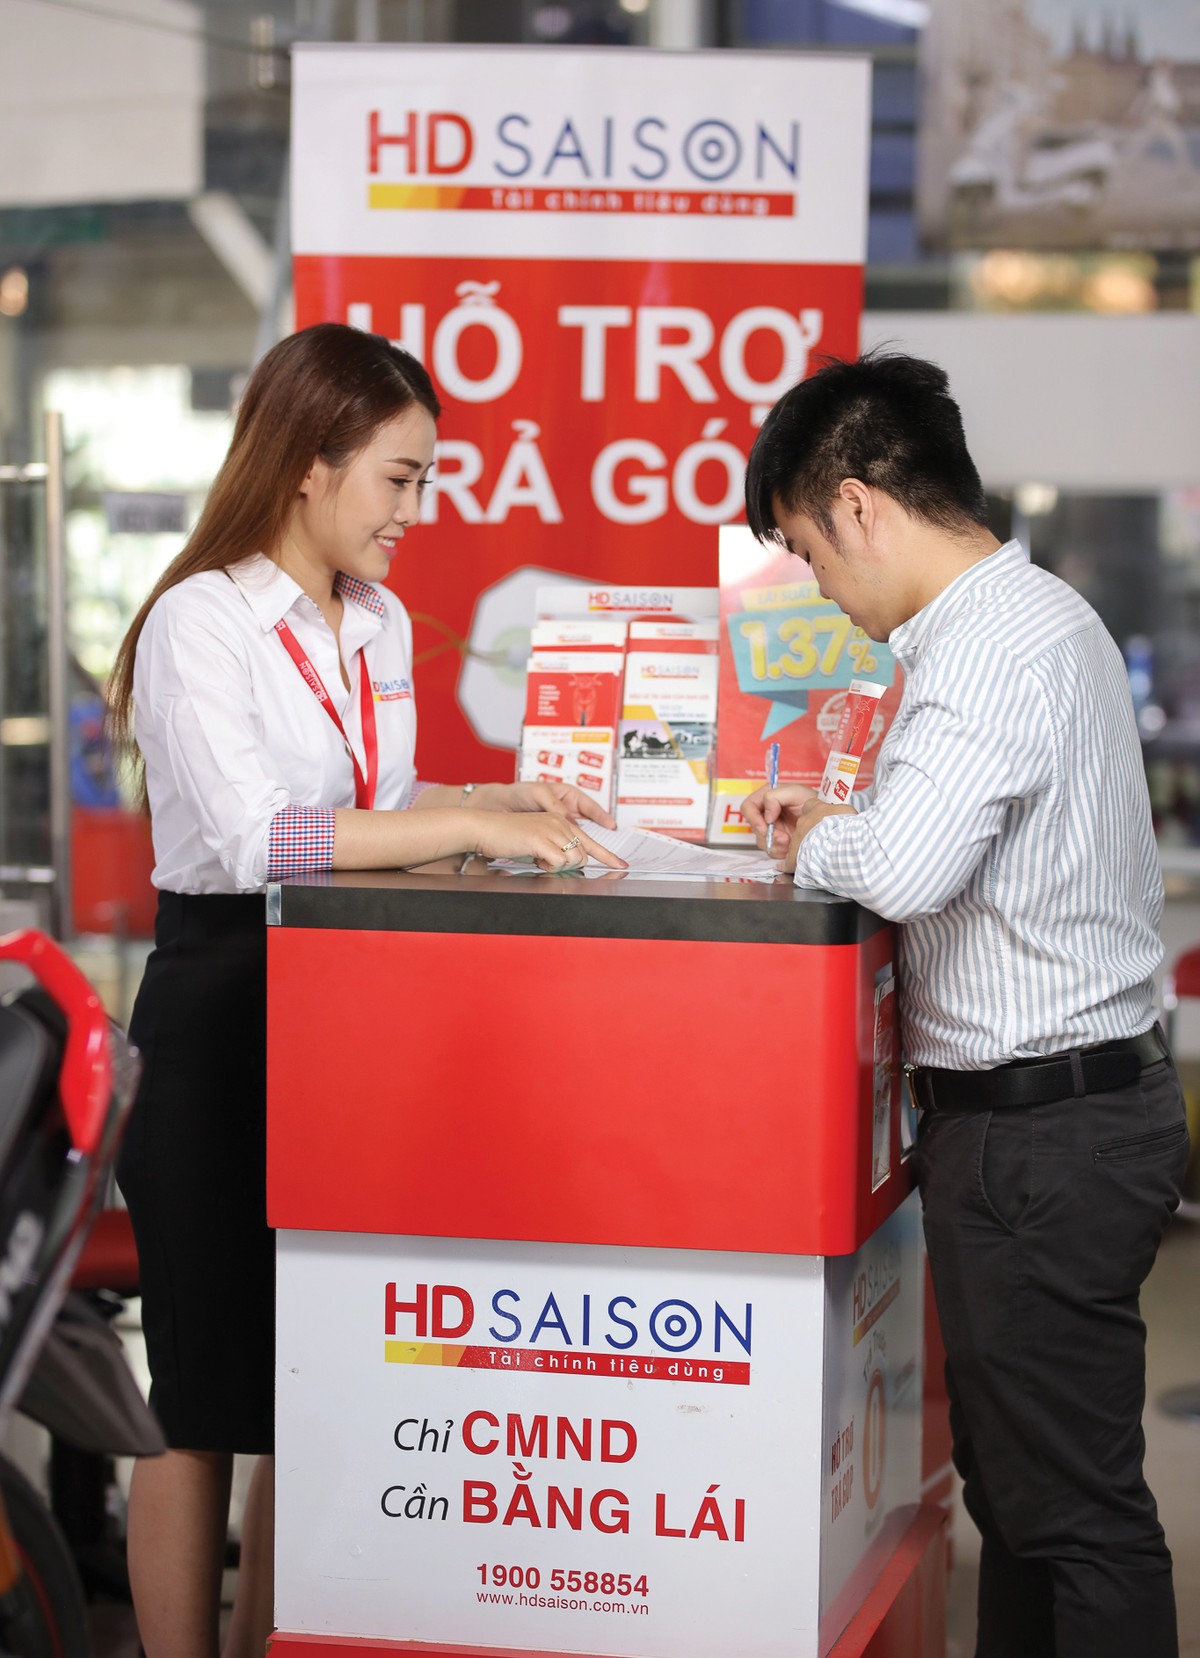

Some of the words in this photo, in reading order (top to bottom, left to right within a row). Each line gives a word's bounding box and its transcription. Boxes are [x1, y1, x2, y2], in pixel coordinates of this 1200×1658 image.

[368, 110, 474, 176] HD
[493, 113, 800, 182] SAISON
[544, 189, 622, 210] chính
[700, 192, 770, 217] dùng
[557, 304, 823, 428] TRỢ
[418, 419, 564, 525] RẢ
[590, 417, 749, 525] GÓ
[588, 591, 611, 606] HD
[612, 591, 674, 606] SAISON
[385, 1281, 475, 1339] HD
[488, 1288, 753, 1357] SAISON
[489, 1351, 521, 1367] Tài
[533, 1353, 597, 1371] chính
[609, 1357, 654, 1375] tiêu
[667, 1361, 726, 1382] dùng
[393, 1418, 454, 1453] Chỉ
[461, 1409, 639, 1464] CMND
[380, 1482, 450, 1521] Cần
[462, 1461, 631, 1535] BẰNG
[654, 1484, 746, 1543] LÁI
[476, 1563, 541, 1590] 1900
[550, 1569, 650, 1597] 558854
[476, 1592, 650, 1616] www.hdsaison.com.vn
